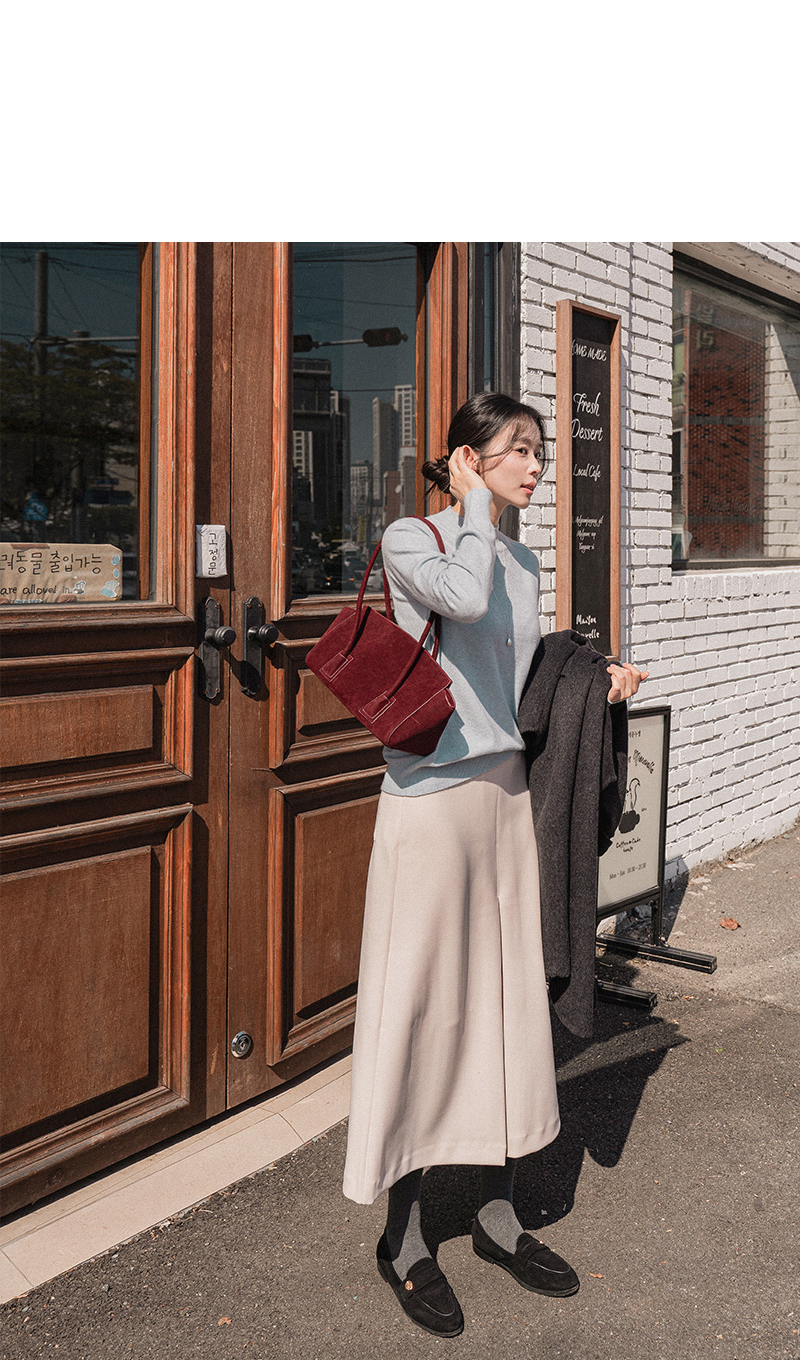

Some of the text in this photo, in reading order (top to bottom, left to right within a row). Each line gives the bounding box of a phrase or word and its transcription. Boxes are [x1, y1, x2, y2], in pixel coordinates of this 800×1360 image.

[587, 348, 607, 362] MADE
[573, 392, 601, 417] Fresh
[572, 418, 603, 442] Dessert
[573, 463, 601, 481] Local Cafe
[49, 550, 102, 574] 출입가능
[208, 532, 218, 576] 고정문
[0, 586, 17, 595] are
